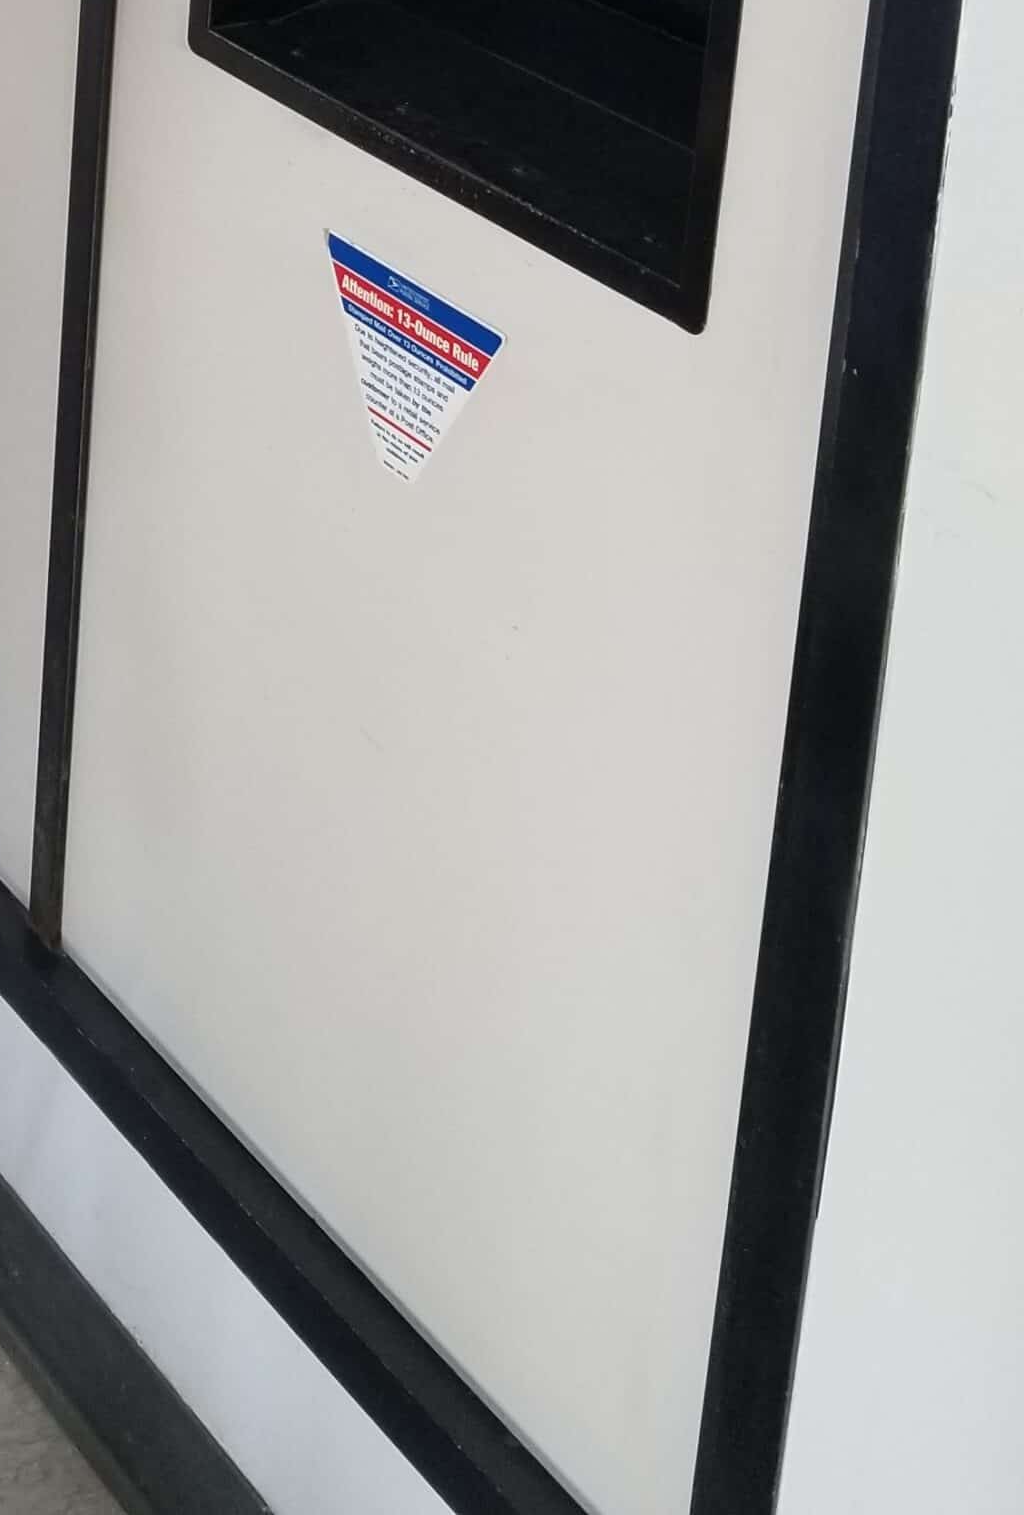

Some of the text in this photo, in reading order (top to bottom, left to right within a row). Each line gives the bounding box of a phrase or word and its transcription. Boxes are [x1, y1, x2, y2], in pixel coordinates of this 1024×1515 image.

[342, 274, 394, 318] Attention:
[397, 309, 450, 353] 13-Ounce
[452, 345, 479, 372] Rule
